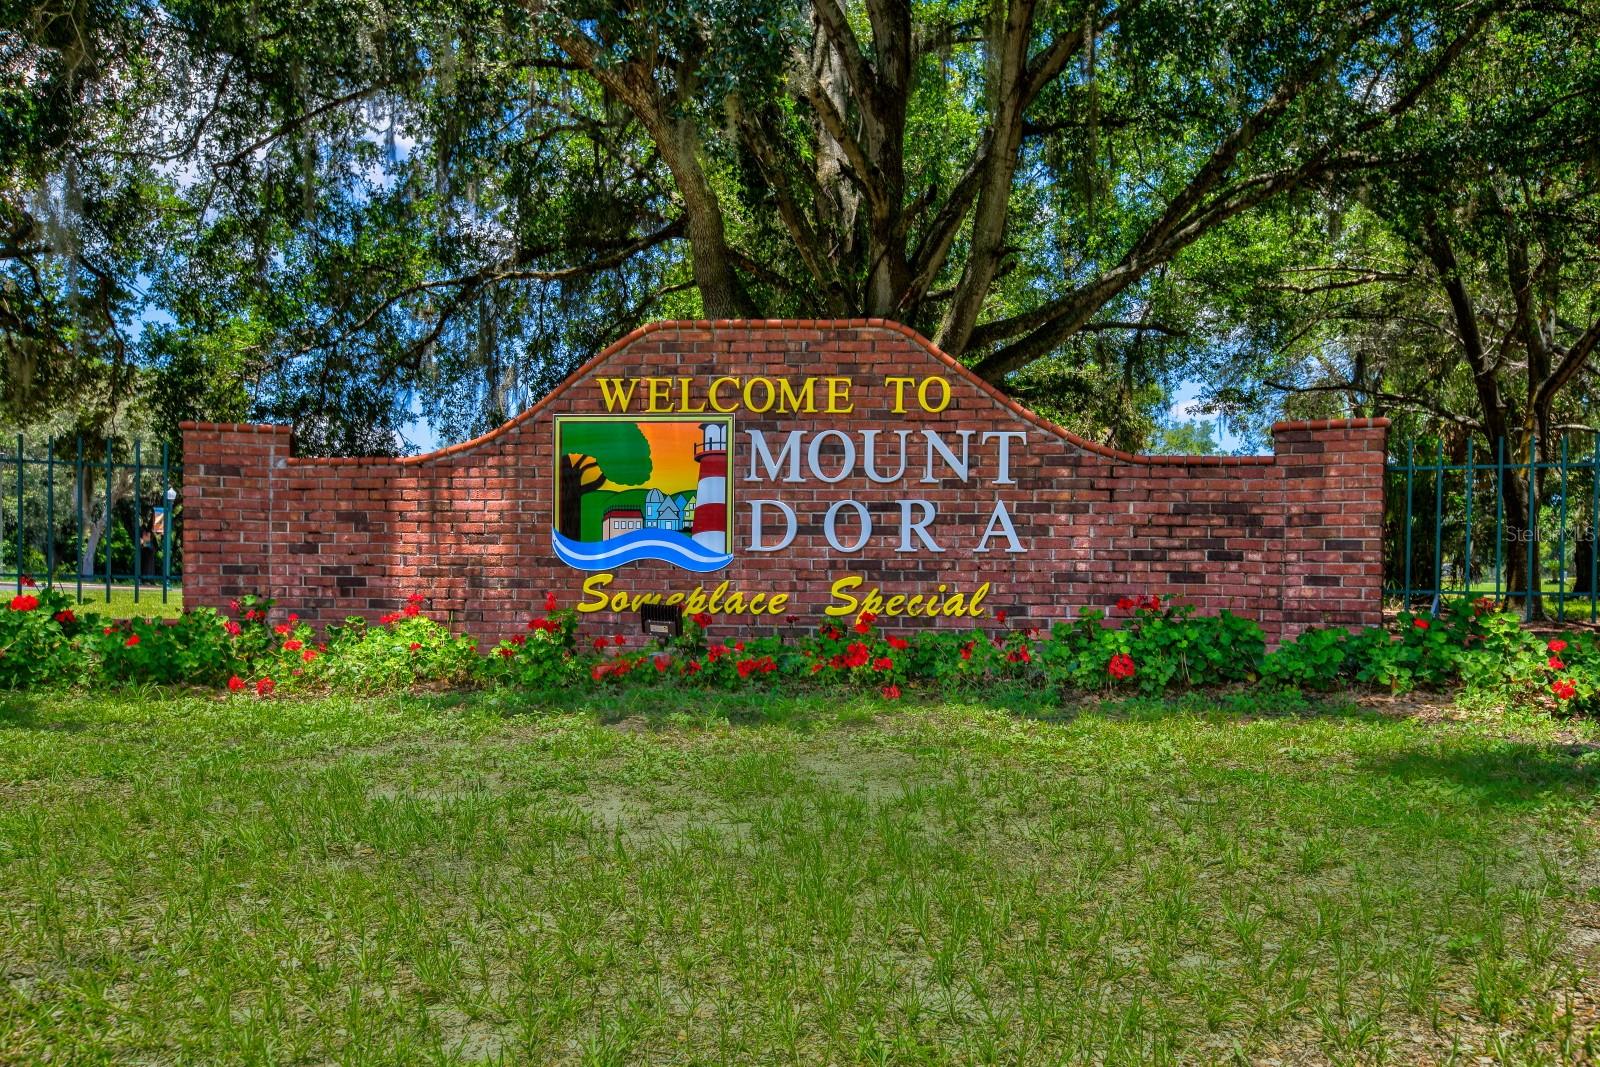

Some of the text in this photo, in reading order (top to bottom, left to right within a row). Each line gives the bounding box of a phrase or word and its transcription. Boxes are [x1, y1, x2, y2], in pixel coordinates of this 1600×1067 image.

[596, 376, 951, 414] WELCOME TO
[744, 429, 1027, 484] MOUNT
[744, 499, 1028, 553] DORA
[825, 575, 991, 626] Special
